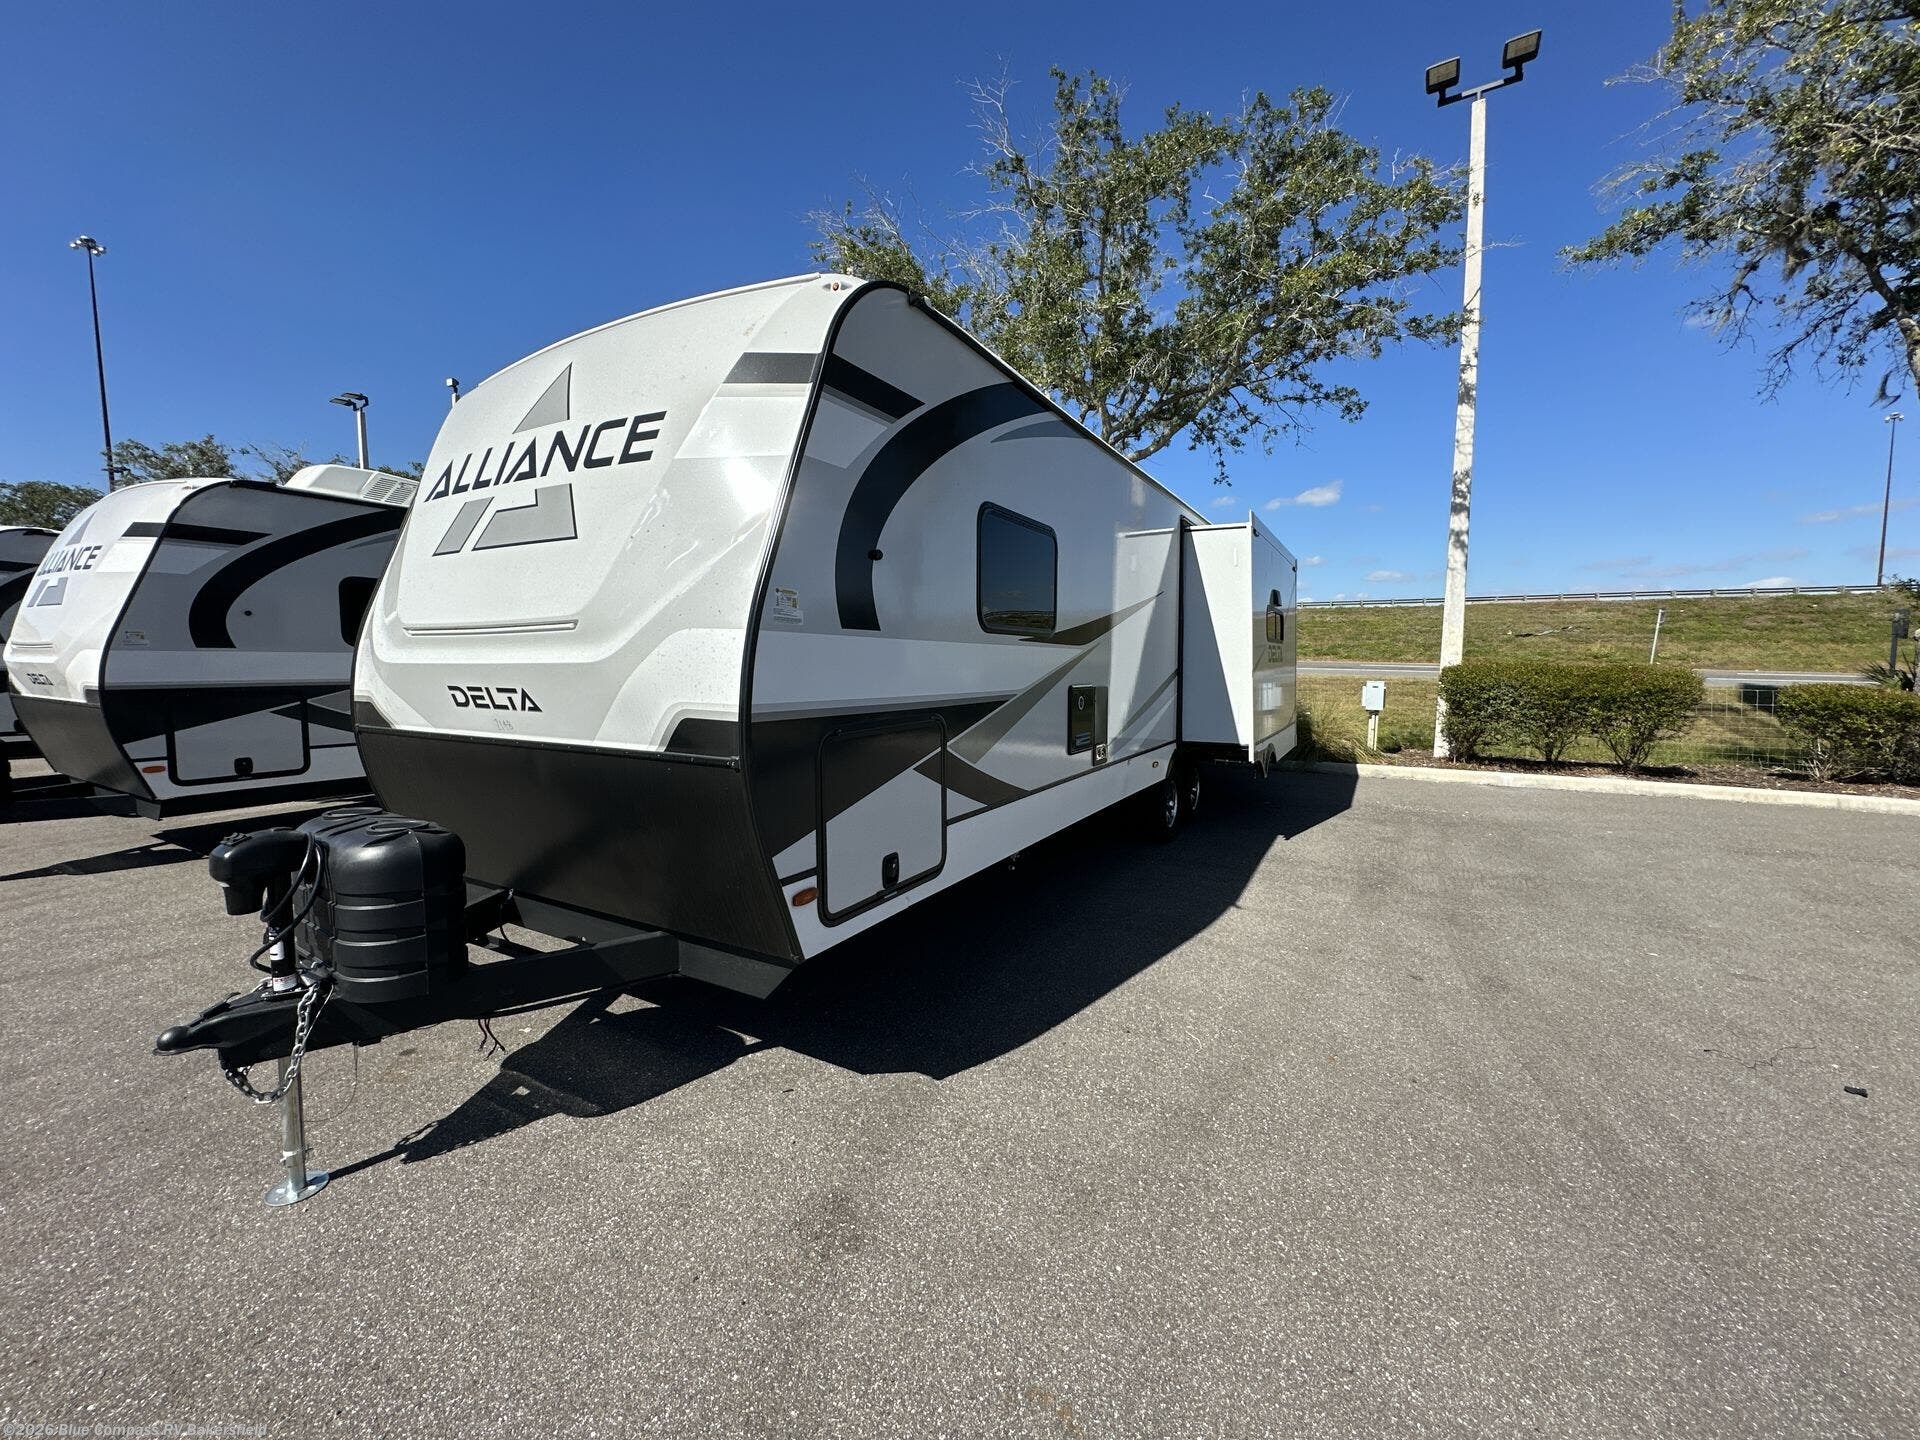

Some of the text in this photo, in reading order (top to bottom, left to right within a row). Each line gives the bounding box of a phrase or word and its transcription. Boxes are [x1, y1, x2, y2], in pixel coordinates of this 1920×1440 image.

[424, 410, 667, 502] ALLIANCE
[27, 673, 54, 686] DELTA
[447, 685, 543, 712] DELTA
